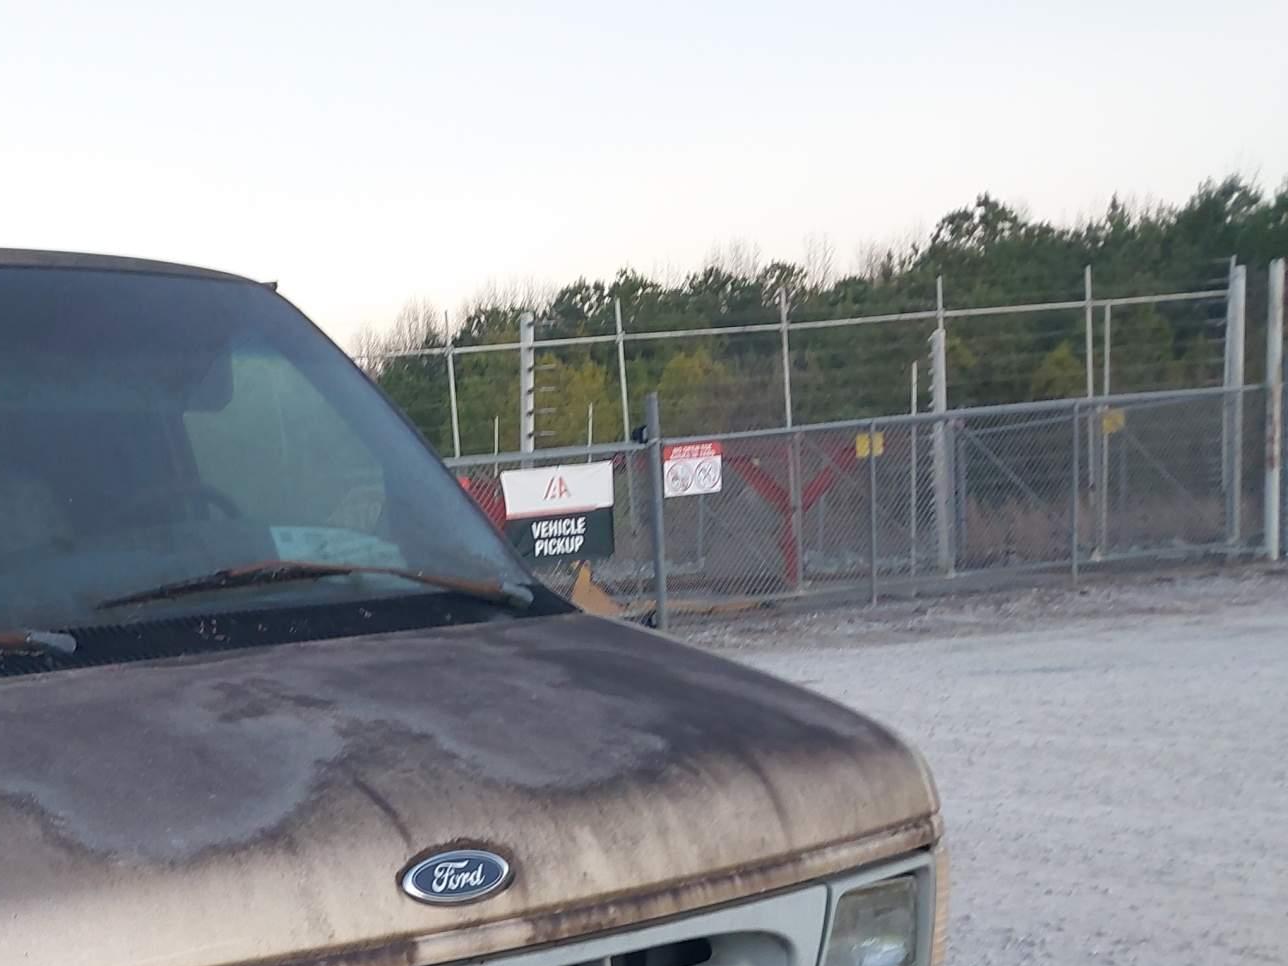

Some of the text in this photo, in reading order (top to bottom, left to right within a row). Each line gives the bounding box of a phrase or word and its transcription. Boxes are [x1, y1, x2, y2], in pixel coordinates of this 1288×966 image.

[532, 517, 586, 539] VEHICLE
[534, 536, 584, 557] PICKUP
[432, 860, 485, 893] Ford
